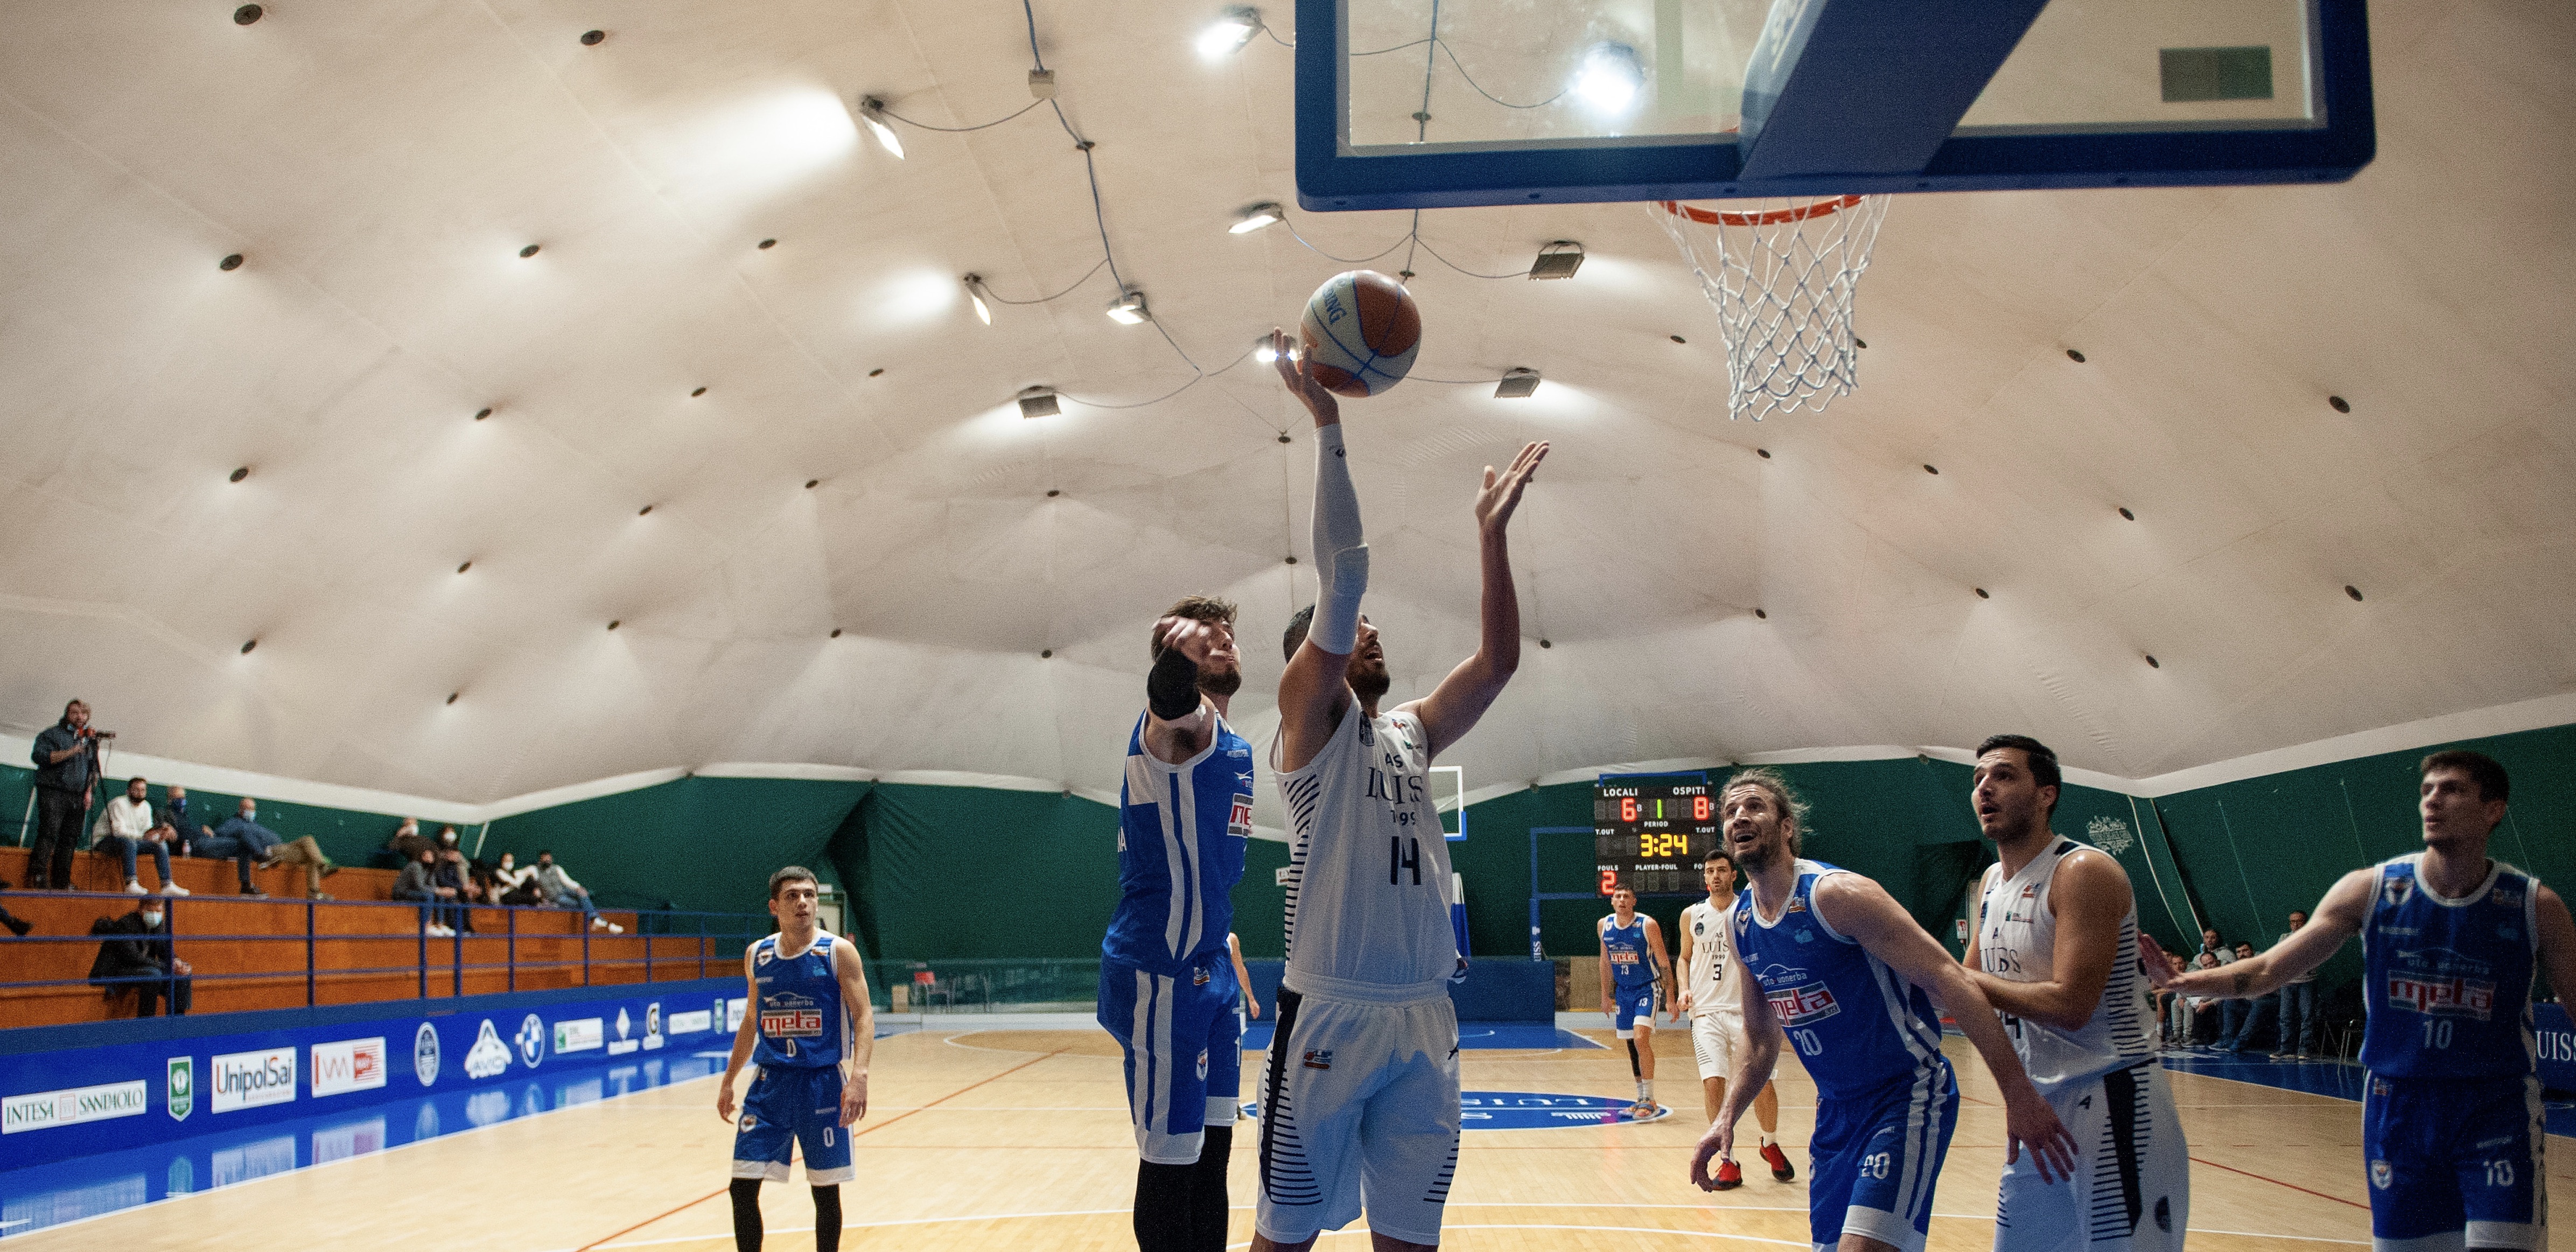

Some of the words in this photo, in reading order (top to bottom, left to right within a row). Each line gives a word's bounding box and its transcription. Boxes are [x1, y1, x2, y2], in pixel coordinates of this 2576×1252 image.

[1385, 753, 1403, 767] AS
[1604, 788, 1638, 797] LOCALI
[1673, 787, 1706, 795] OSPITI
[1621, 798, 1637, 822] 6
[1693, 796, 1709, 820] 8
[1640, 834, 1688, 857] 3:24
[1390, 836, 1422, 886] 14
[1601, 870, 1616, 895] 2
[1621, 964, 1629, 975] 13
[1713, 964, 1722, 981] 3
[1639, 997, 1648, 1007] 13
[2390, 978, 2493, 1012] meta
[762, 1011, 821, 1036] meta
[2424, 1020, 2452, 1050] 10
[1793, 1029, 1822, 1056] 20
[2536, 1031, 2576, 1061] UIS
[216, 1056, 292, 1101] UnipolSai
[6, 1101, 54, 1125] INTESA
[79, 1088, 143, 1115] SANPAOLO
[823, 1127, 835, 1148] 0
[1861, 1152, 1890, 1179] 20
[2483, 1160, 2515, 1187] 10
